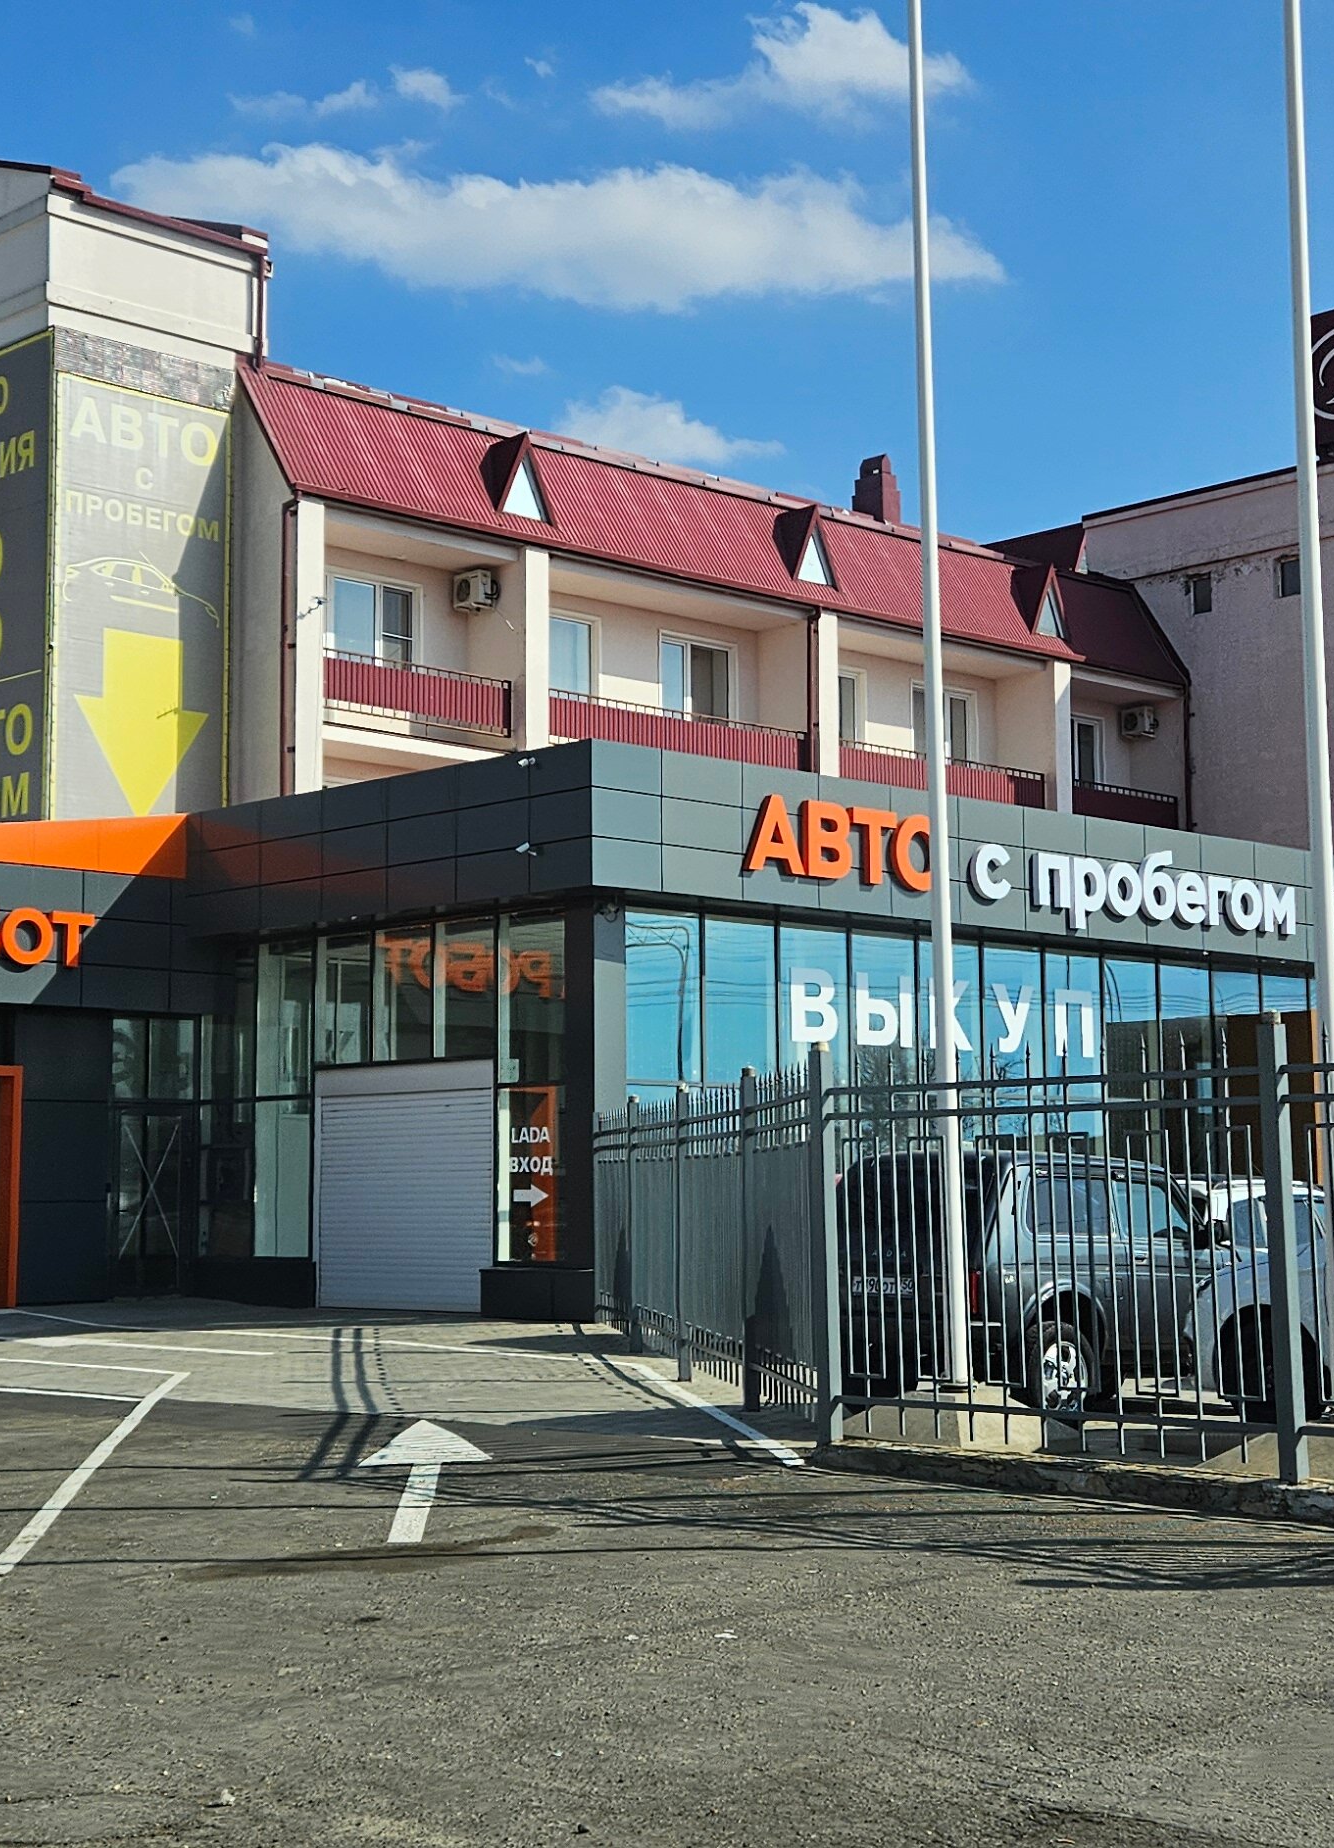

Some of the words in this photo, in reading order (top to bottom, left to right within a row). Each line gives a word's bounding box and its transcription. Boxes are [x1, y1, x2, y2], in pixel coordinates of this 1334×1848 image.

[70, 396, 218, 467] АВТО
[66, 489, 219, 542] ПРОБЕГОМ
[743, 794, 932, 892] АВТО
[969, 843, 1011, 900] с
[1032, 850, 1297, 936] пробегом
[511, 1126, 551, 1144] LADA
[509, 1156, 553, 1176] ВХОД
